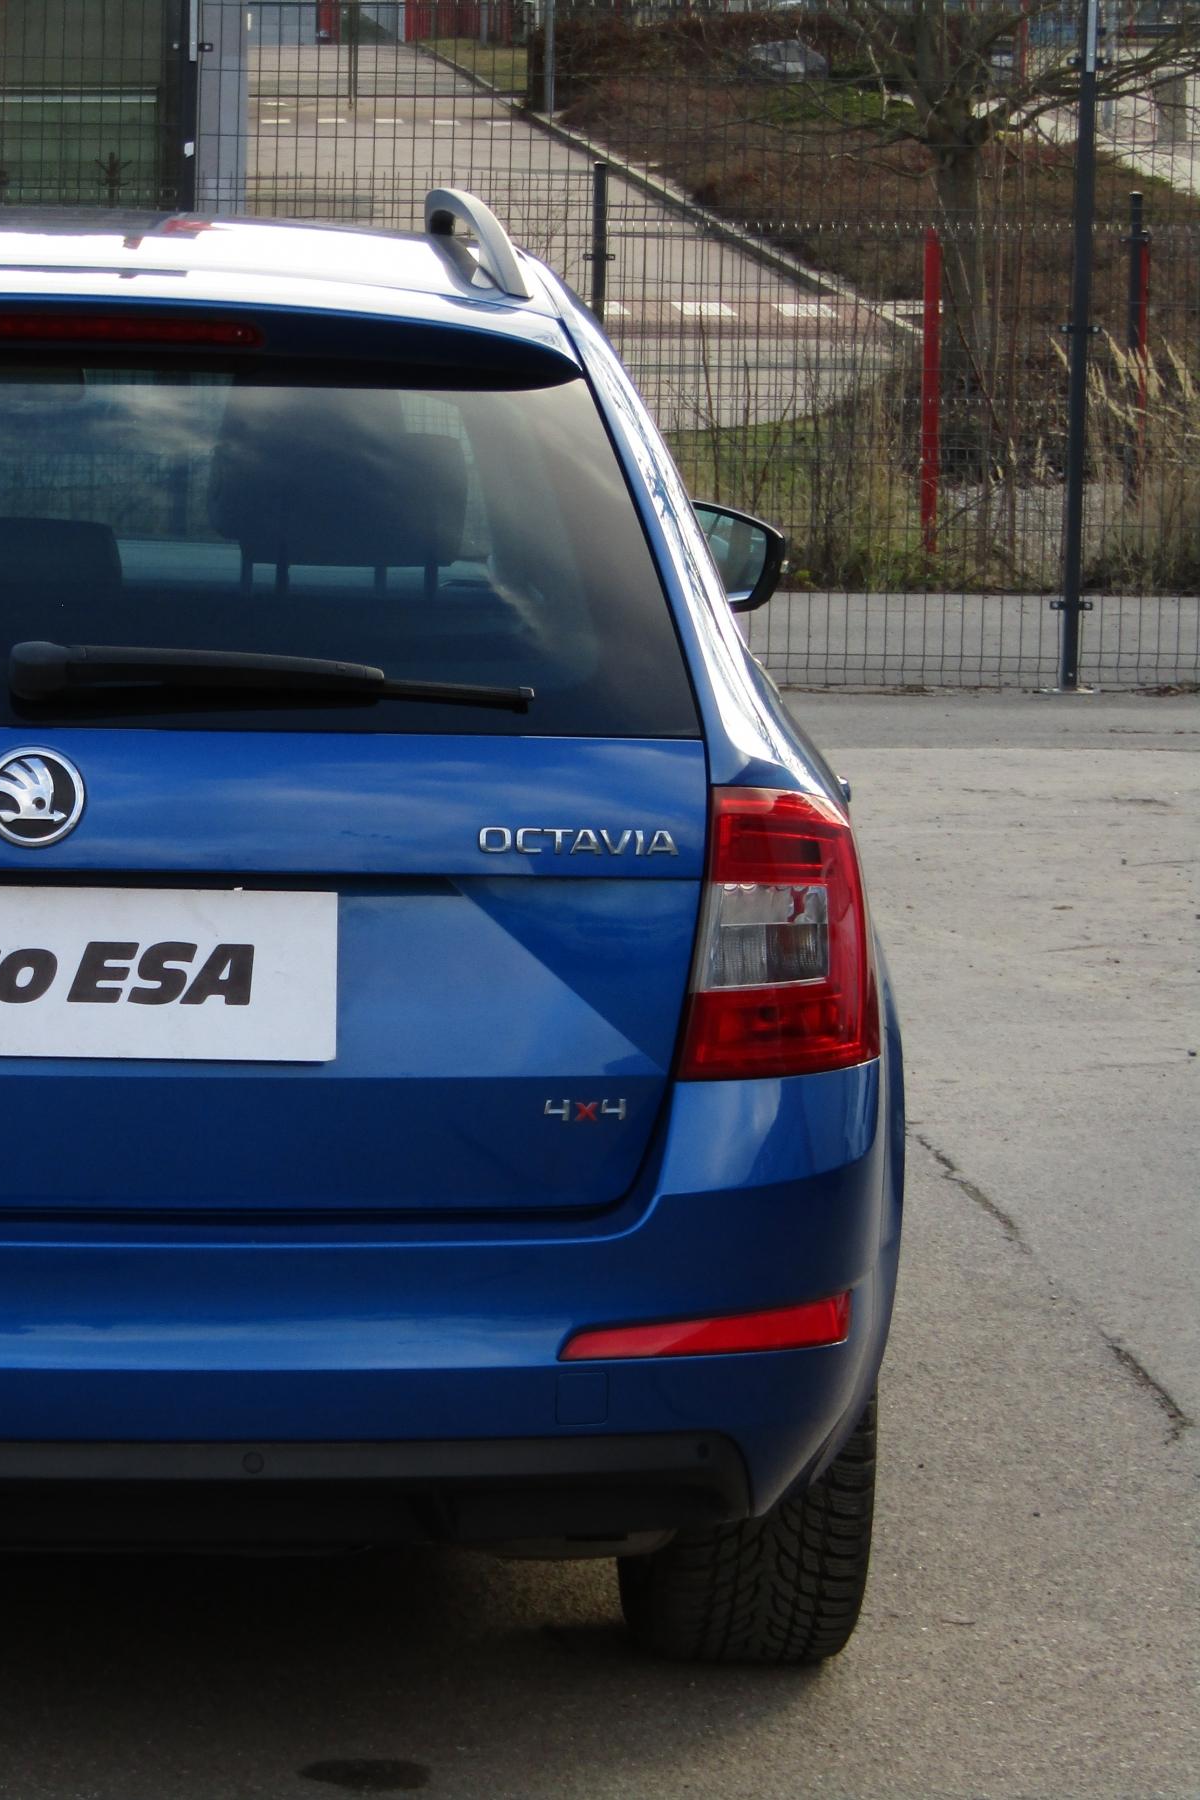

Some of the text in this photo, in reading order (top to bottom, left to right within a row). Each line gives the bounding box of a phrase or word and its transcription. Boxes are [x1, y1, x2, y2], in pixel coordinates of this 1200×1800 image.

[478, 826, 679, 856] OCTAVIA
[66, 940, 255, 1006] ESA
[543, 1098, 627, 1121] 4x4
